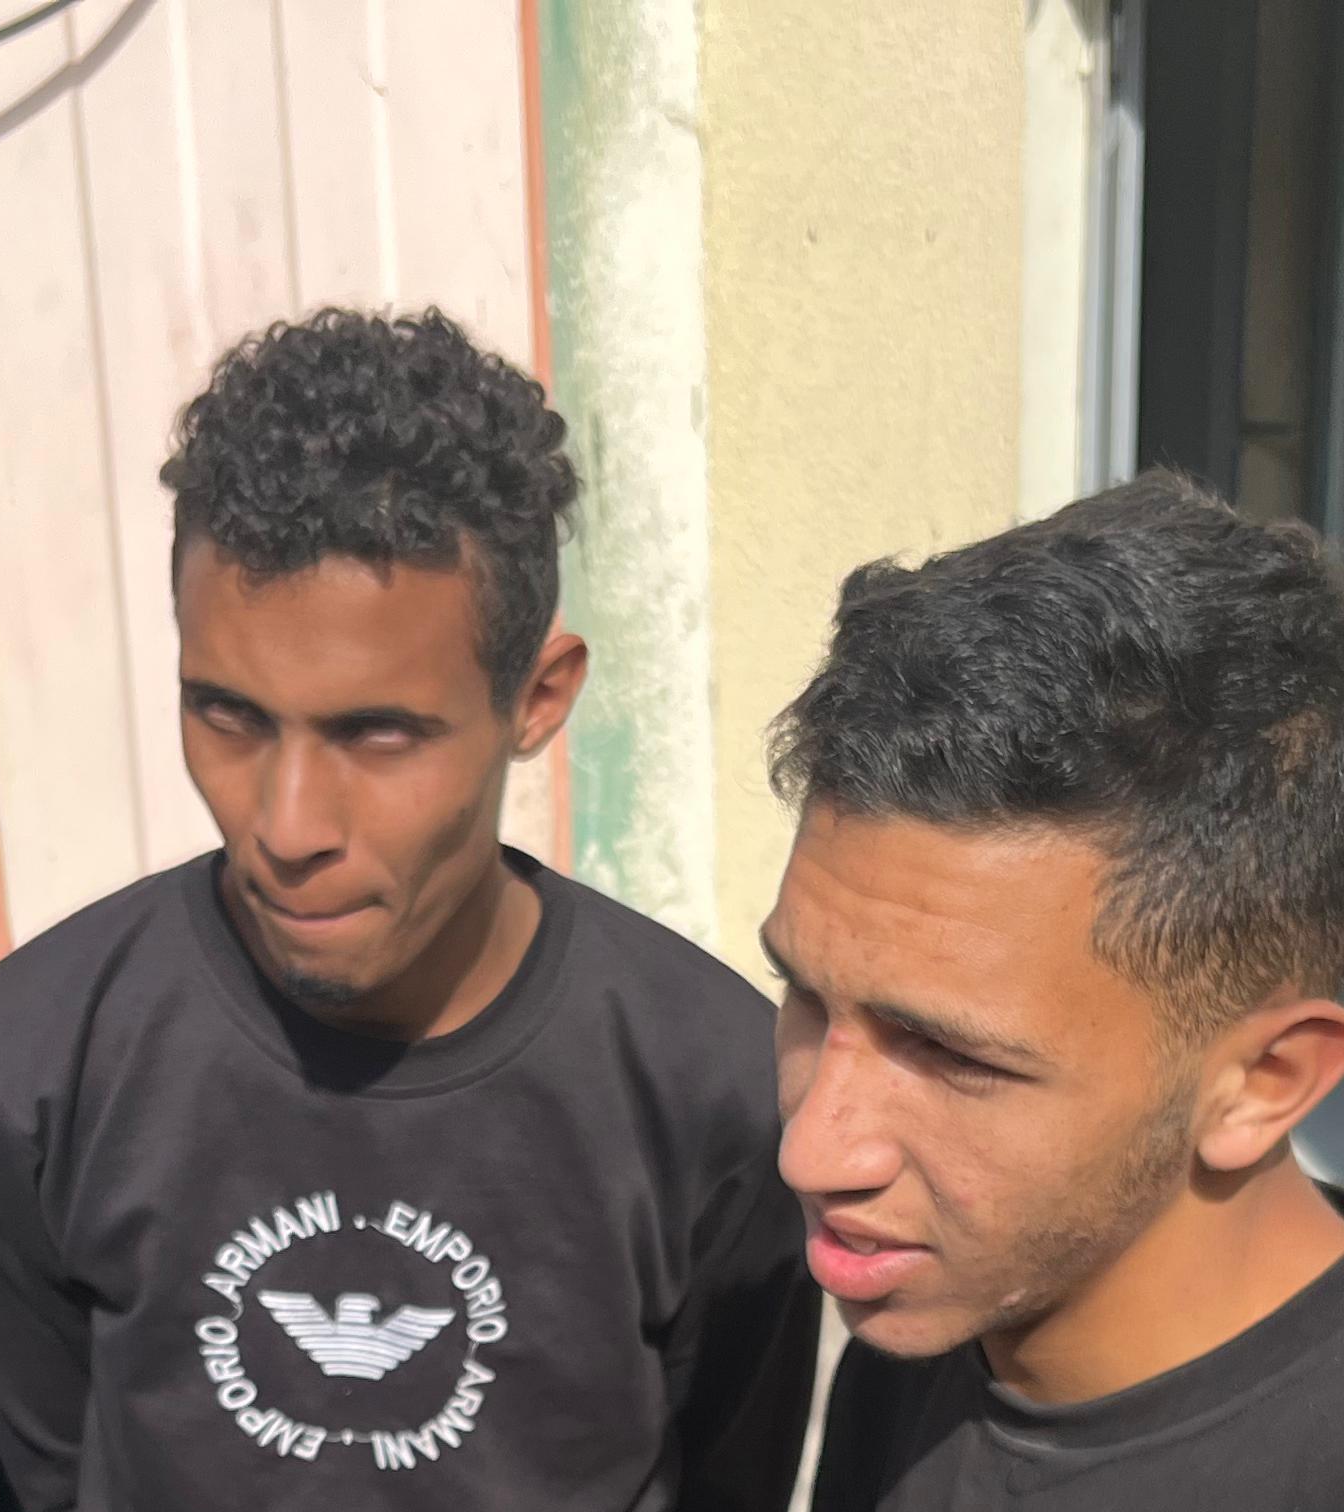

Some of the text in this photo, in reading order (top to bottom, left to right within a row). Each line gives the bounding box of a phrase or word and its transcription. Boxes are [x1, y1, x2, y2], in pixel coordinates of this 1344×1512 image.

[195, 1190, 341, 1462] EMPORIO ARMANI
[369, 1201, 508, 1471] EMPORIO ARMANI
